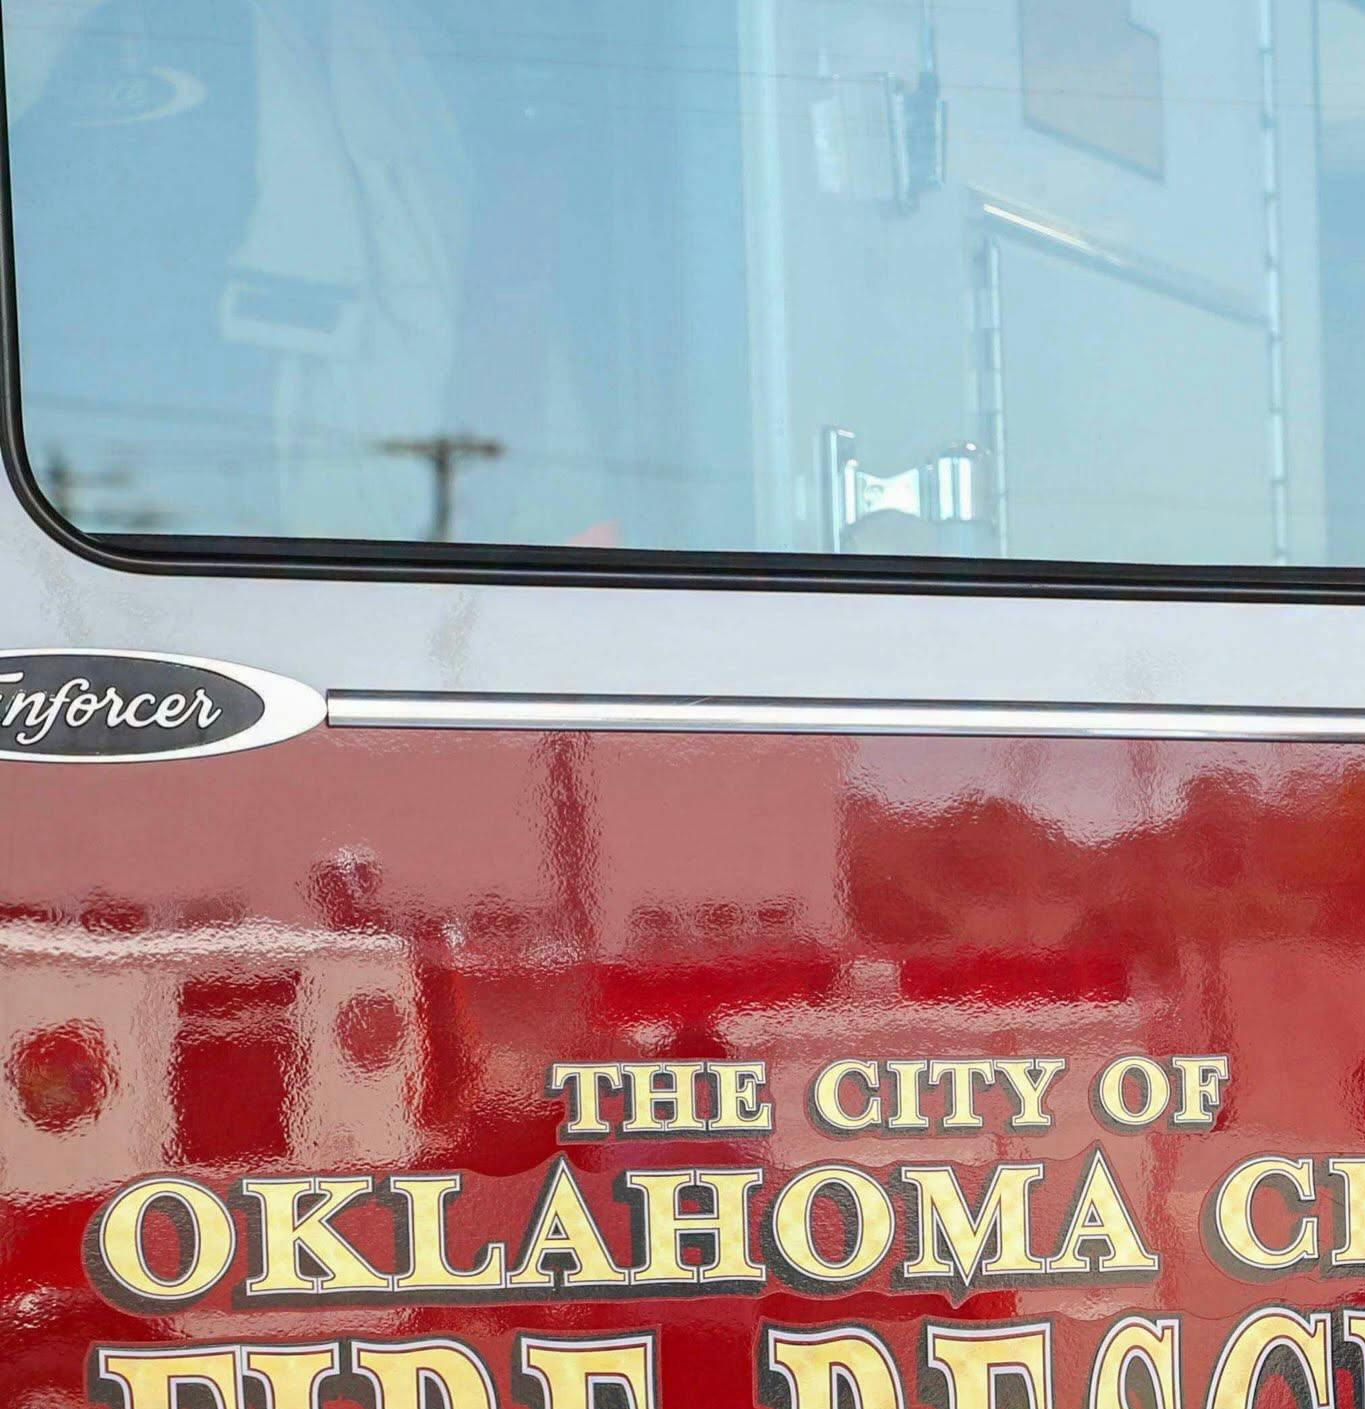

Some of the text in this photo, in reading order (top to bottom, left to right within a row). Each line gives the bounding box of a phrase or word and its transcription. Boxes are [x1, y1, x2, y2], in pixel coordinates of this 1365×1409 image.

[550, 1053, 1229, 1134] THE CITY OF
[99, 1150, 1160, 1302] OKLAHOMA
